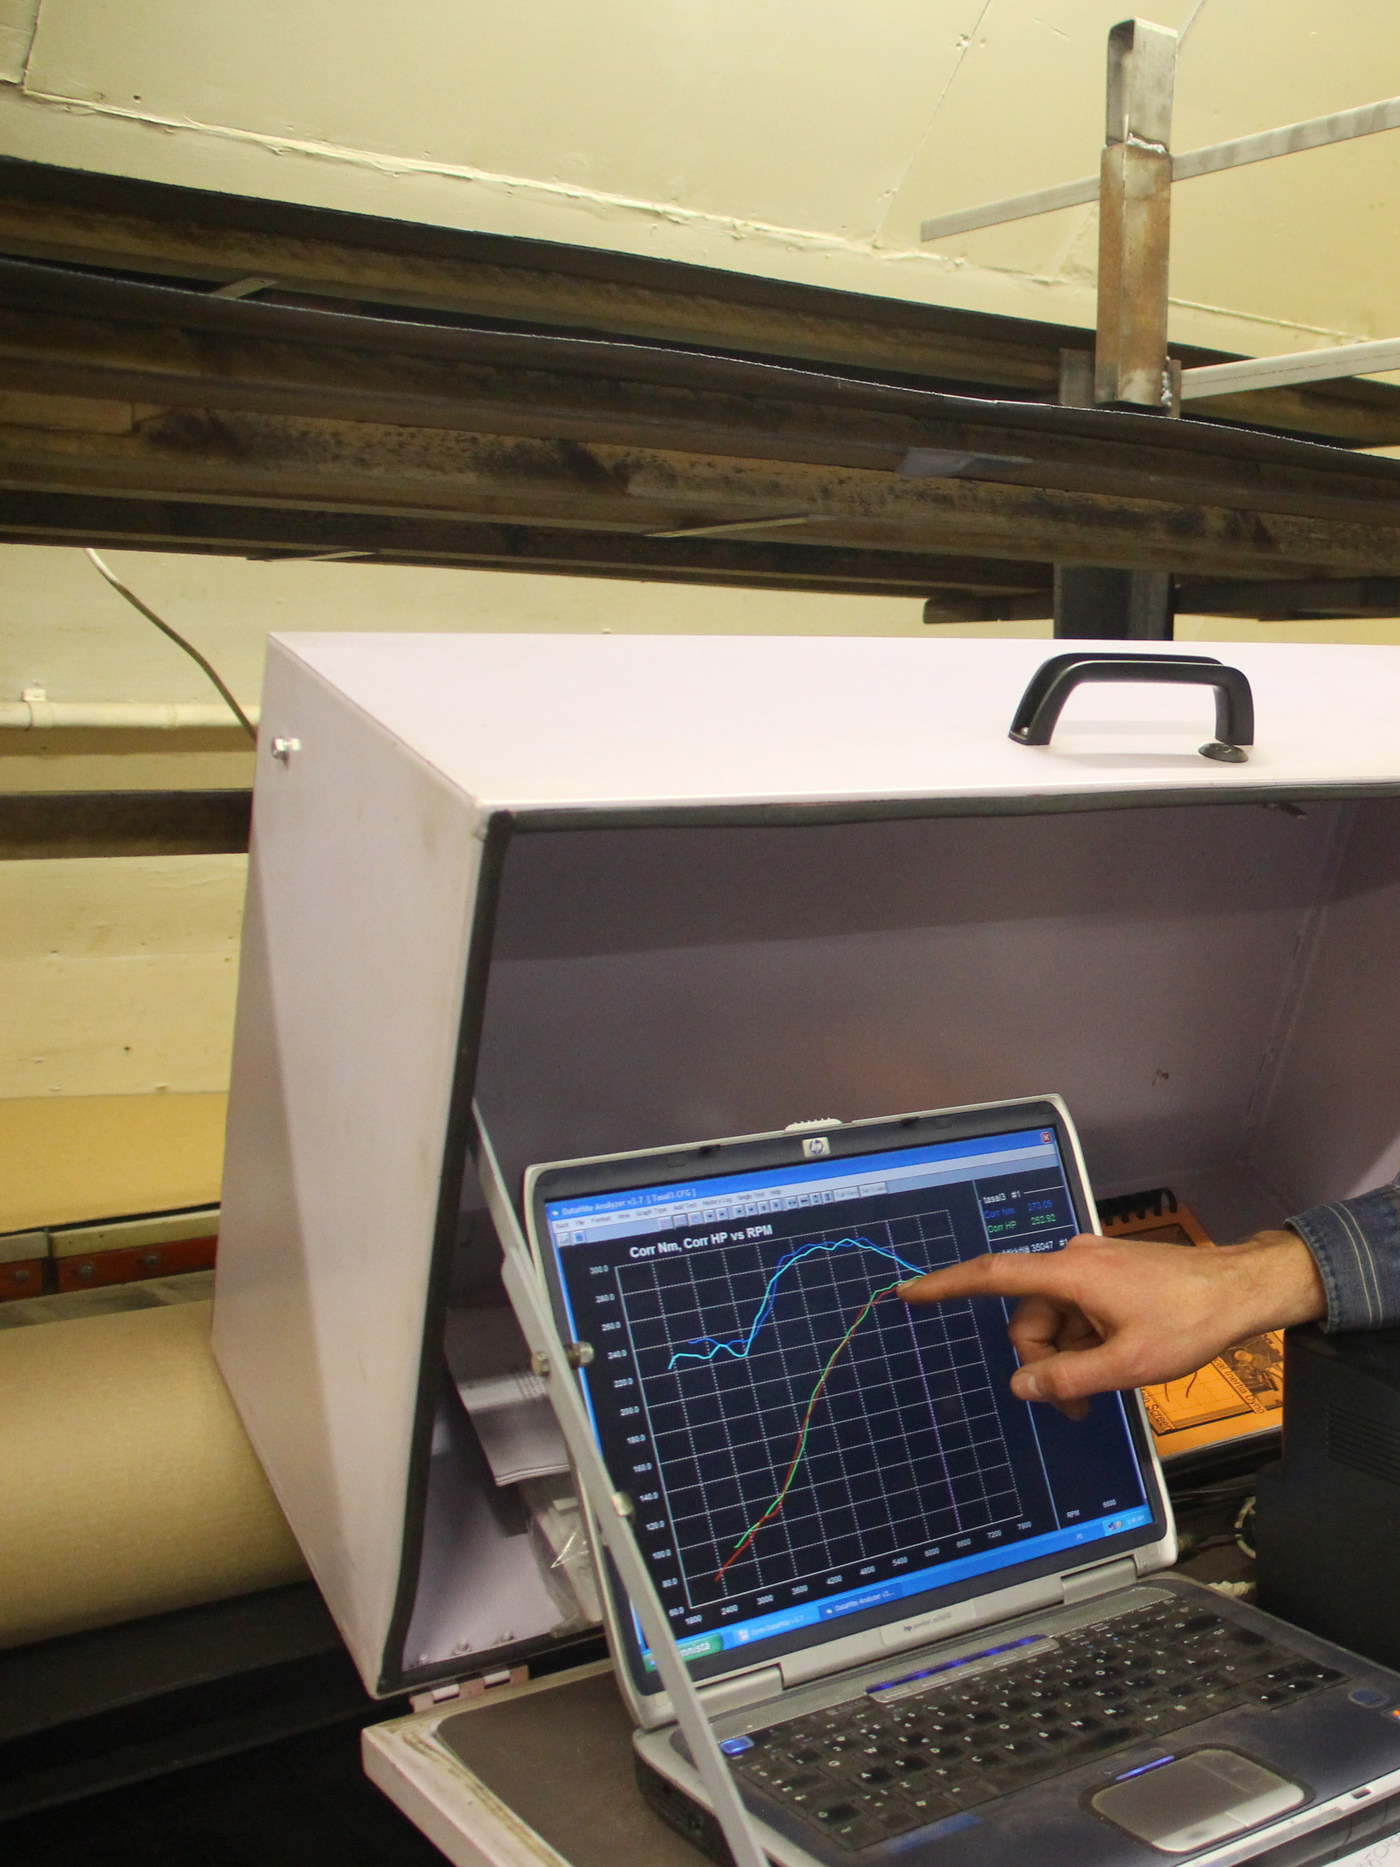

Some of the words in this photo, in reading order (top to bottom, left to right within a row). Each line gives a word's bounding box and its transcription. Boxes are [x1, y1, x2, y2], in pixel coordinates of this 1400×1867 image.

[1005, 1220, 1017, 1231] HP
[629, 1242, 657, 1259] Corr
[658, 1239, 682, 1254] Nm,
[683, 1236, 710, 1250] Corr
[711, 1231, 728, 1245] HP
[730, 1230, 745, 1241] vs
[746, 1223, 773, 1238] RPM
[1150, 1403, 1173, 1431] Screen
[679, 1640, 711, 1657] nnistä
